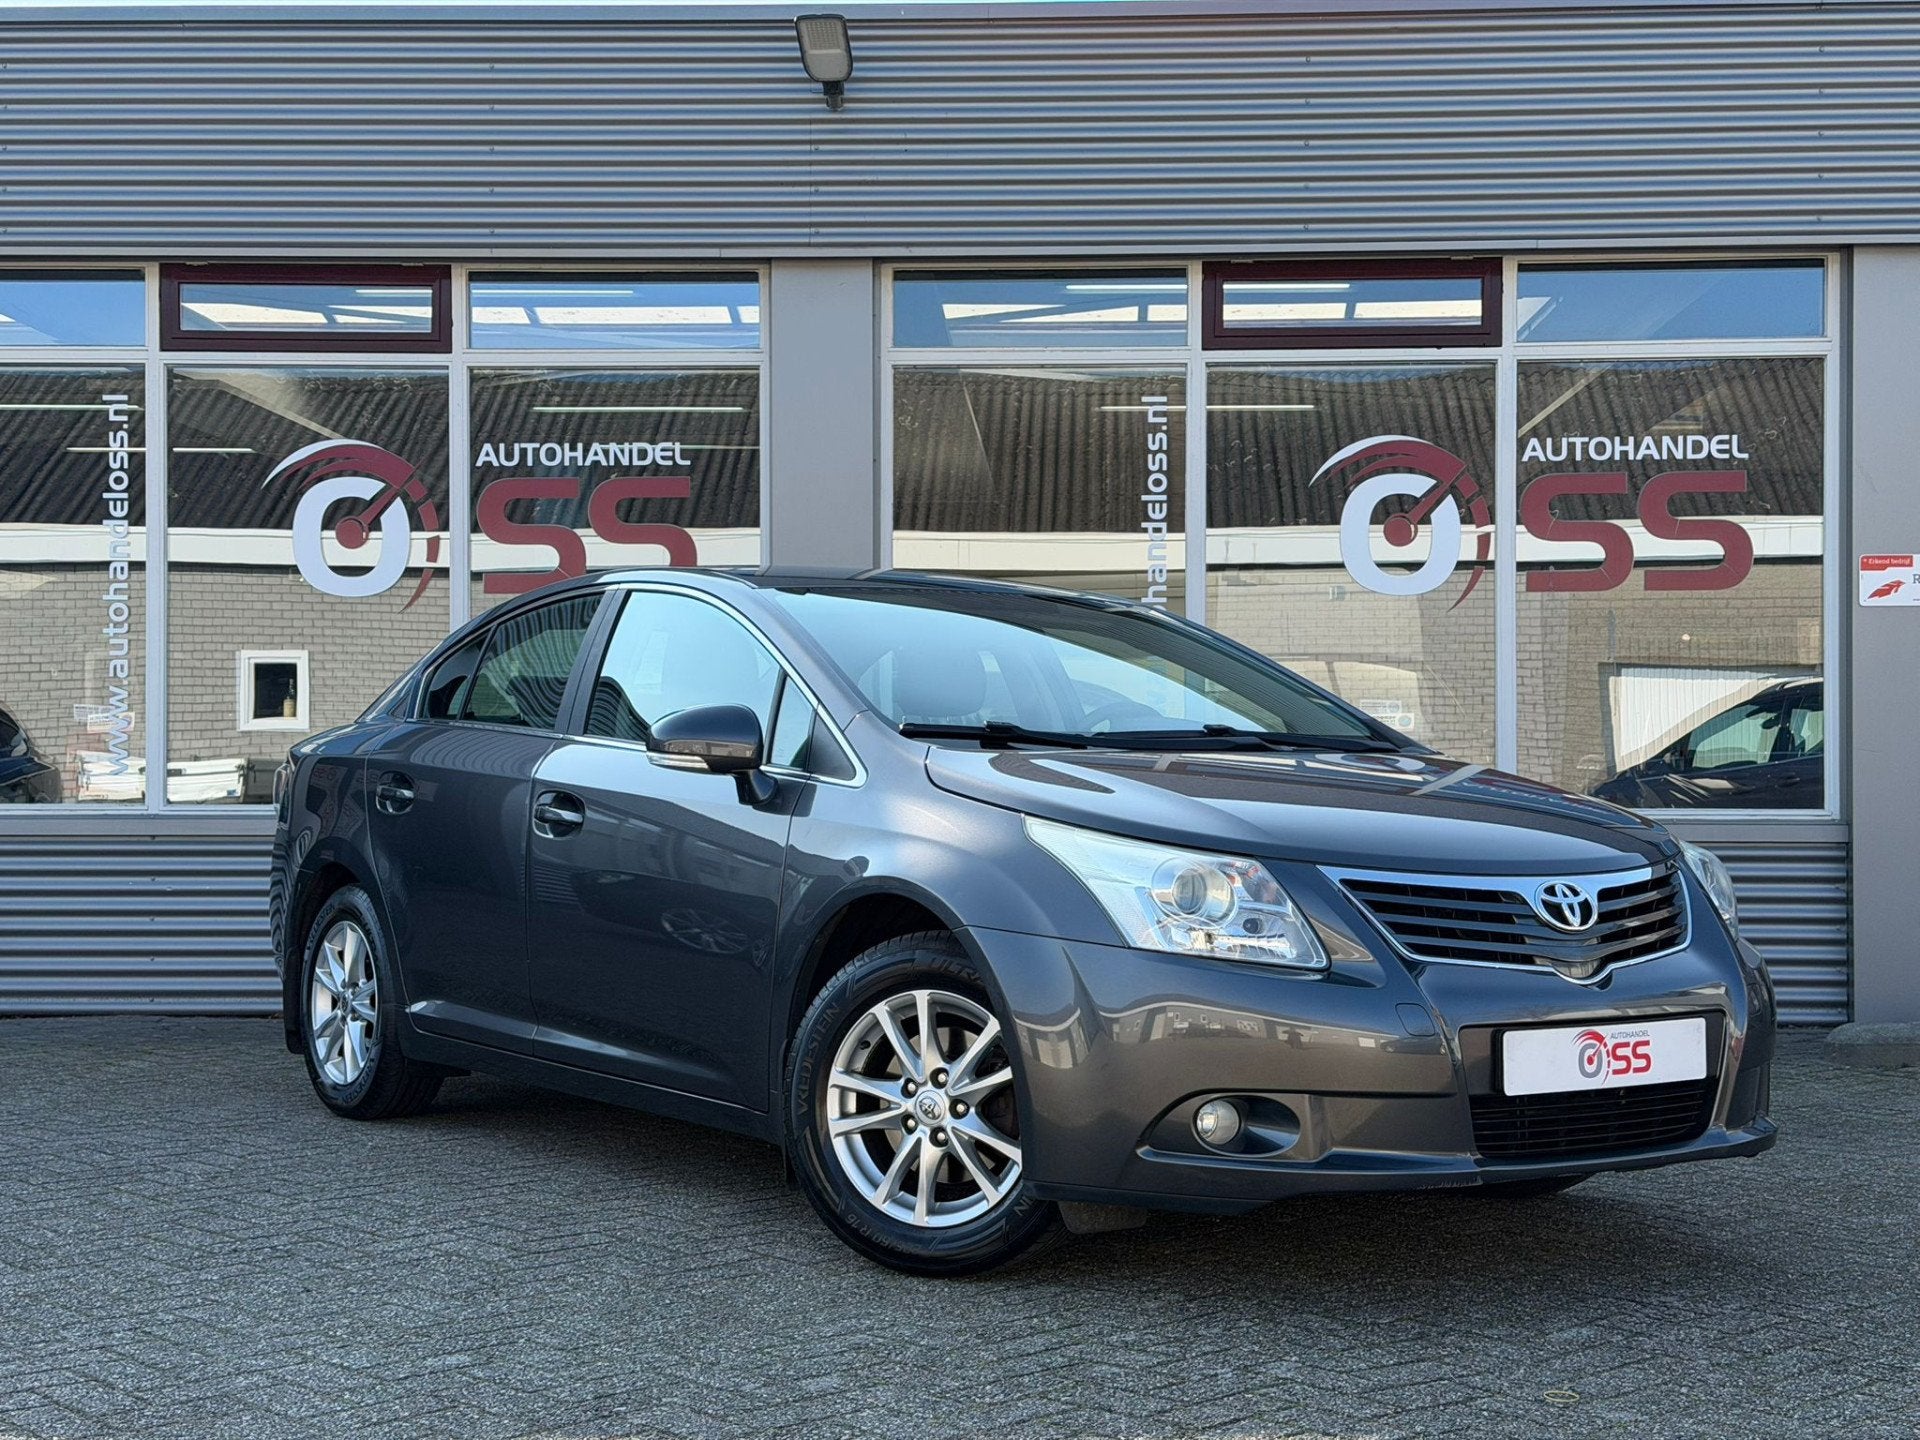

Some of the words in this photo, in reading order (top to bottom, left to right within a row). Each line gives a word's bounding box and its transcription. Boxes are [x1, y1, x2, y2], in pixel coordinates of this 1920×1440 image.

[475, 441, 691, 467] AUTOHANDEL
[1521, 433, 1749, 463] AUTOHANDEL
[1140, 395, 1168, 613] handeloss.nl
[101, 393, 129, 776] www.autohandeloss.nl
[1610, 1030, 1650, 1040] AUTOHANDEL
